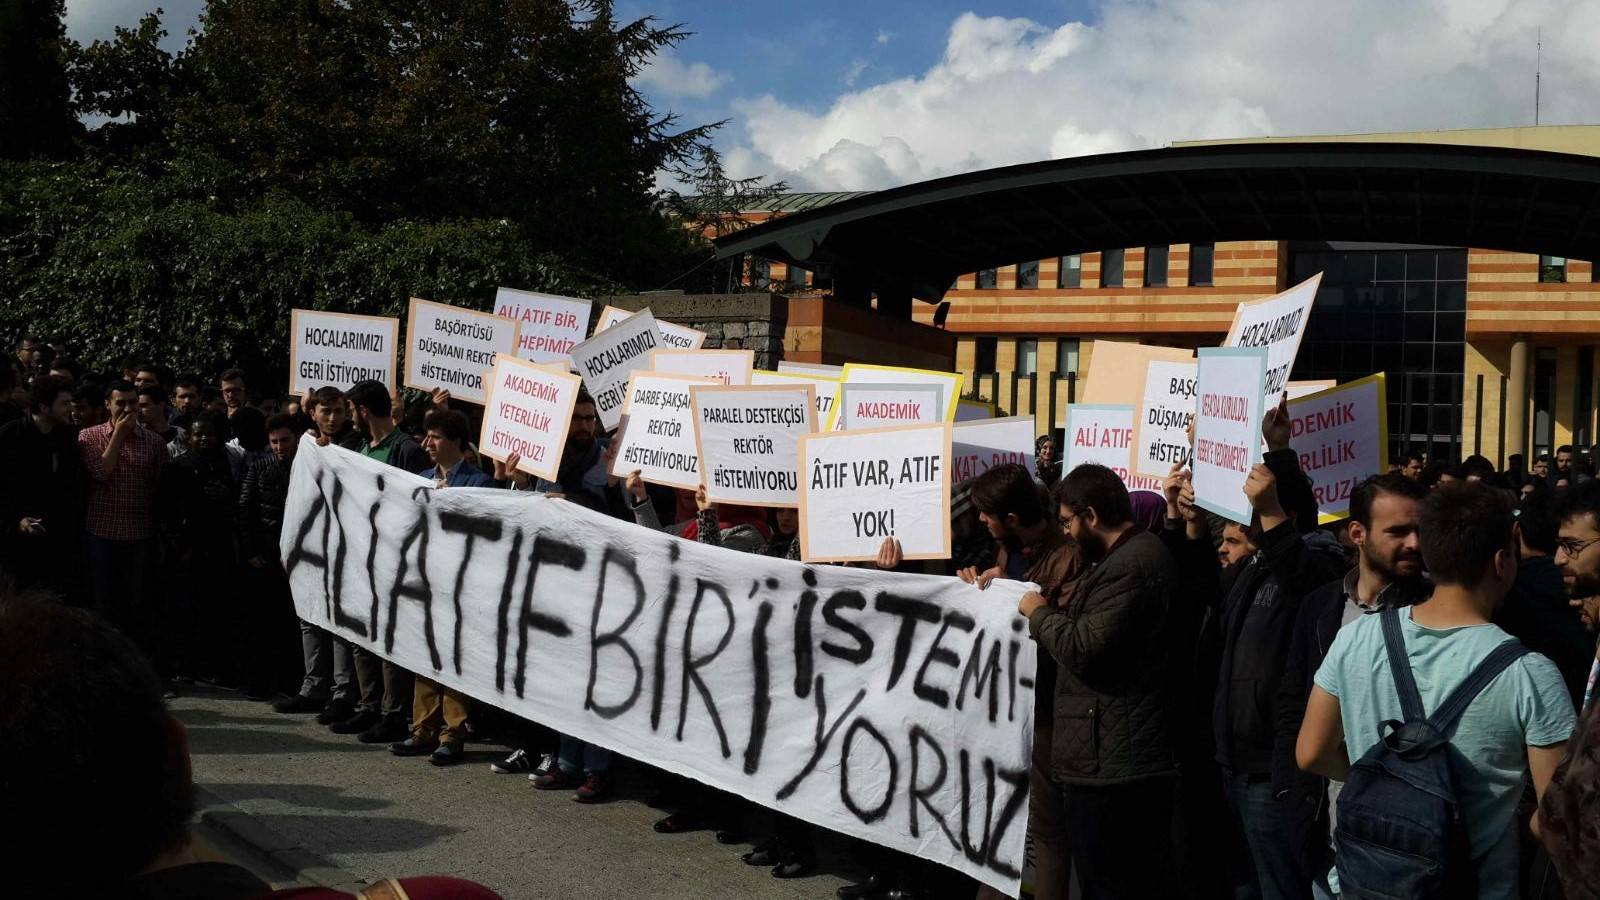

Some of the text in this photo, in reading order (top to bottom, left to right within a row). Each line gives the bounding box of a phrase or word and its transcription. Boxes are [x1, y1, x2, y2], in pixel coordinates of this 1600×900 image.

[434, 318, 493, 342] BAŞÖRTÜSÜ
[498, 303, 580, 332] ALİ ATIF BİR,
[305, 327, 383, 353] HOCALARIMIZI
[418, 337, 497, 367] DÜŞMANI REKTÖ
[584, 329, 657, 378] HOCALARIMIZI
[300, 359, 324, 379] GERİ
[421, 363, 484, 390] #İSTEMİYOR
[503, 373, 560, 404] AKADEMİK
[597, 382, 622, 412] GERİ
[634, 388, 661, 406] DARBE
[661, 391, 691, 412] ŞAKŞA
[499, 400, 552, 433] YETERLİLİK
[703, 404, 805, 428] PARALEL DESTEKÇİSİ
[857, 399, 921, 420] AKADEMİK
[1148, 405, 1190, 431] DÜŞMA
[1290, 401, 1356, 438] DEMİK
[647, 418, 682, 438] REKTÖR
[1075, 423, 1133, 449] ALİ ATIF
[491, 426, 546, 462] İSTİYORUZ!
[624, 442, 698, 473] #İSTEMİYORUZ
[733, 434, 774, 455] REKTÖR
[1149, 438, 1193, 466] #İSTEM
[1300, 440, 1356, 471] RLİLİK
[714, 464, 797, 491] #İSTEMİYORU
[811, 455, 940, 490] ÂTIF VAR, ATIF
[852, 508, 895, 538] YOK!
[286, 468, 385, 642] ALİ
[777, 674, 1030, 880] YORUZ
